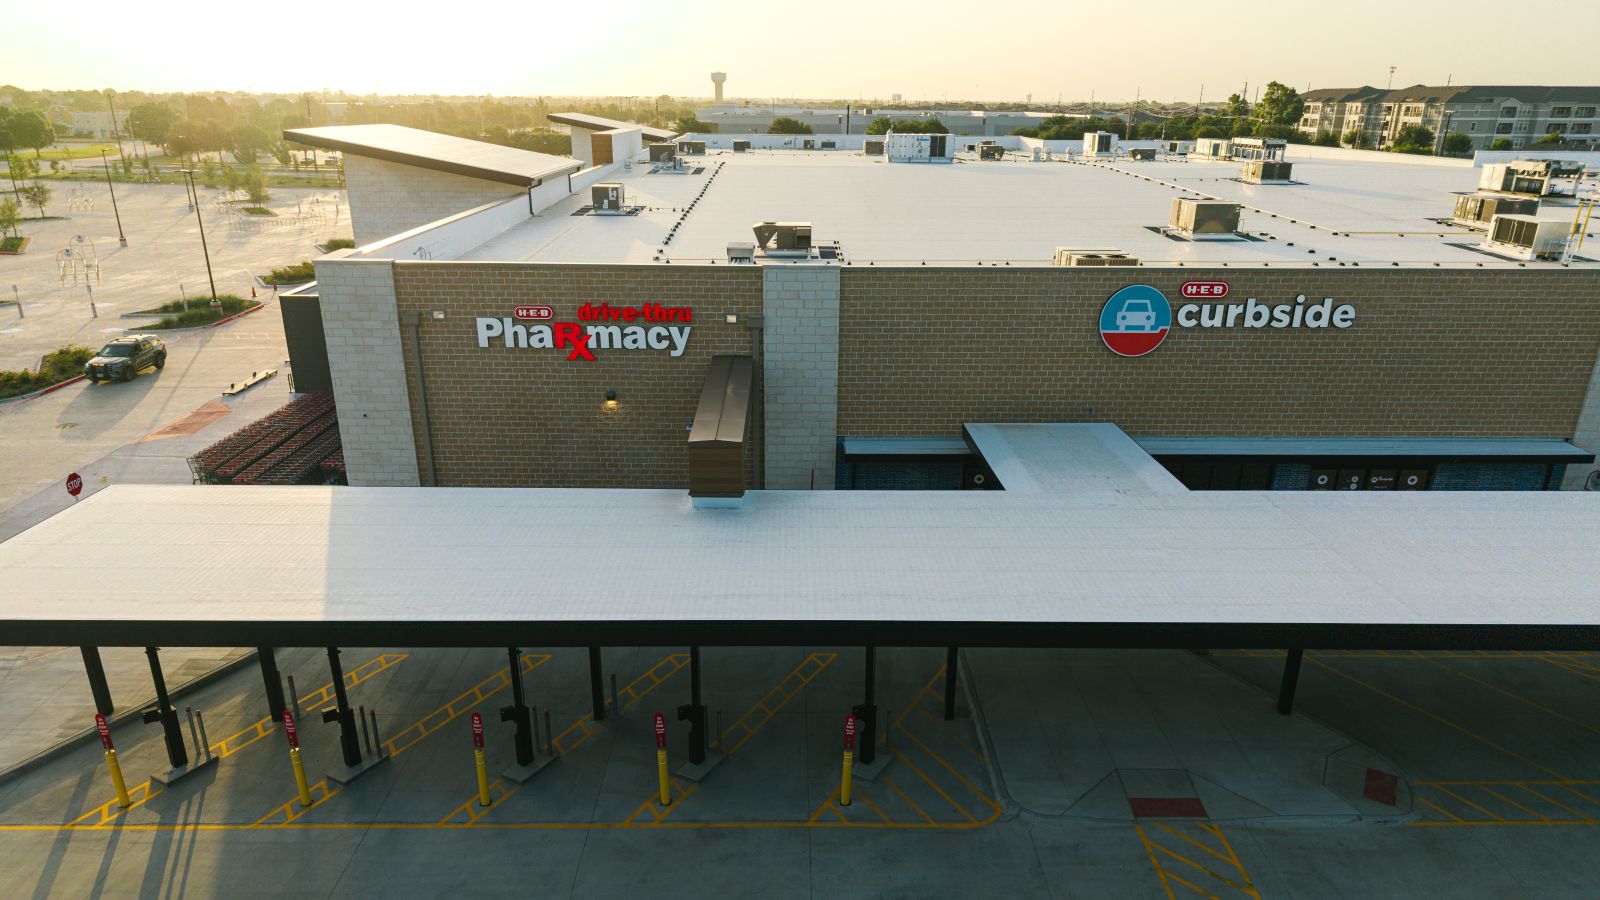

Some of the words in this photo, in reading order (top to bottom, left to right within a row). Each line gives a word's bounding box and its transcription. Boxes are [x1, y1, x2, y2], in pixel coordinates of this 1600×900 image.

[577, 303, 692, 322] drive-thru
[1177, 295, 1356, 328] curbside
[67, 478, 80, 491] STOP
